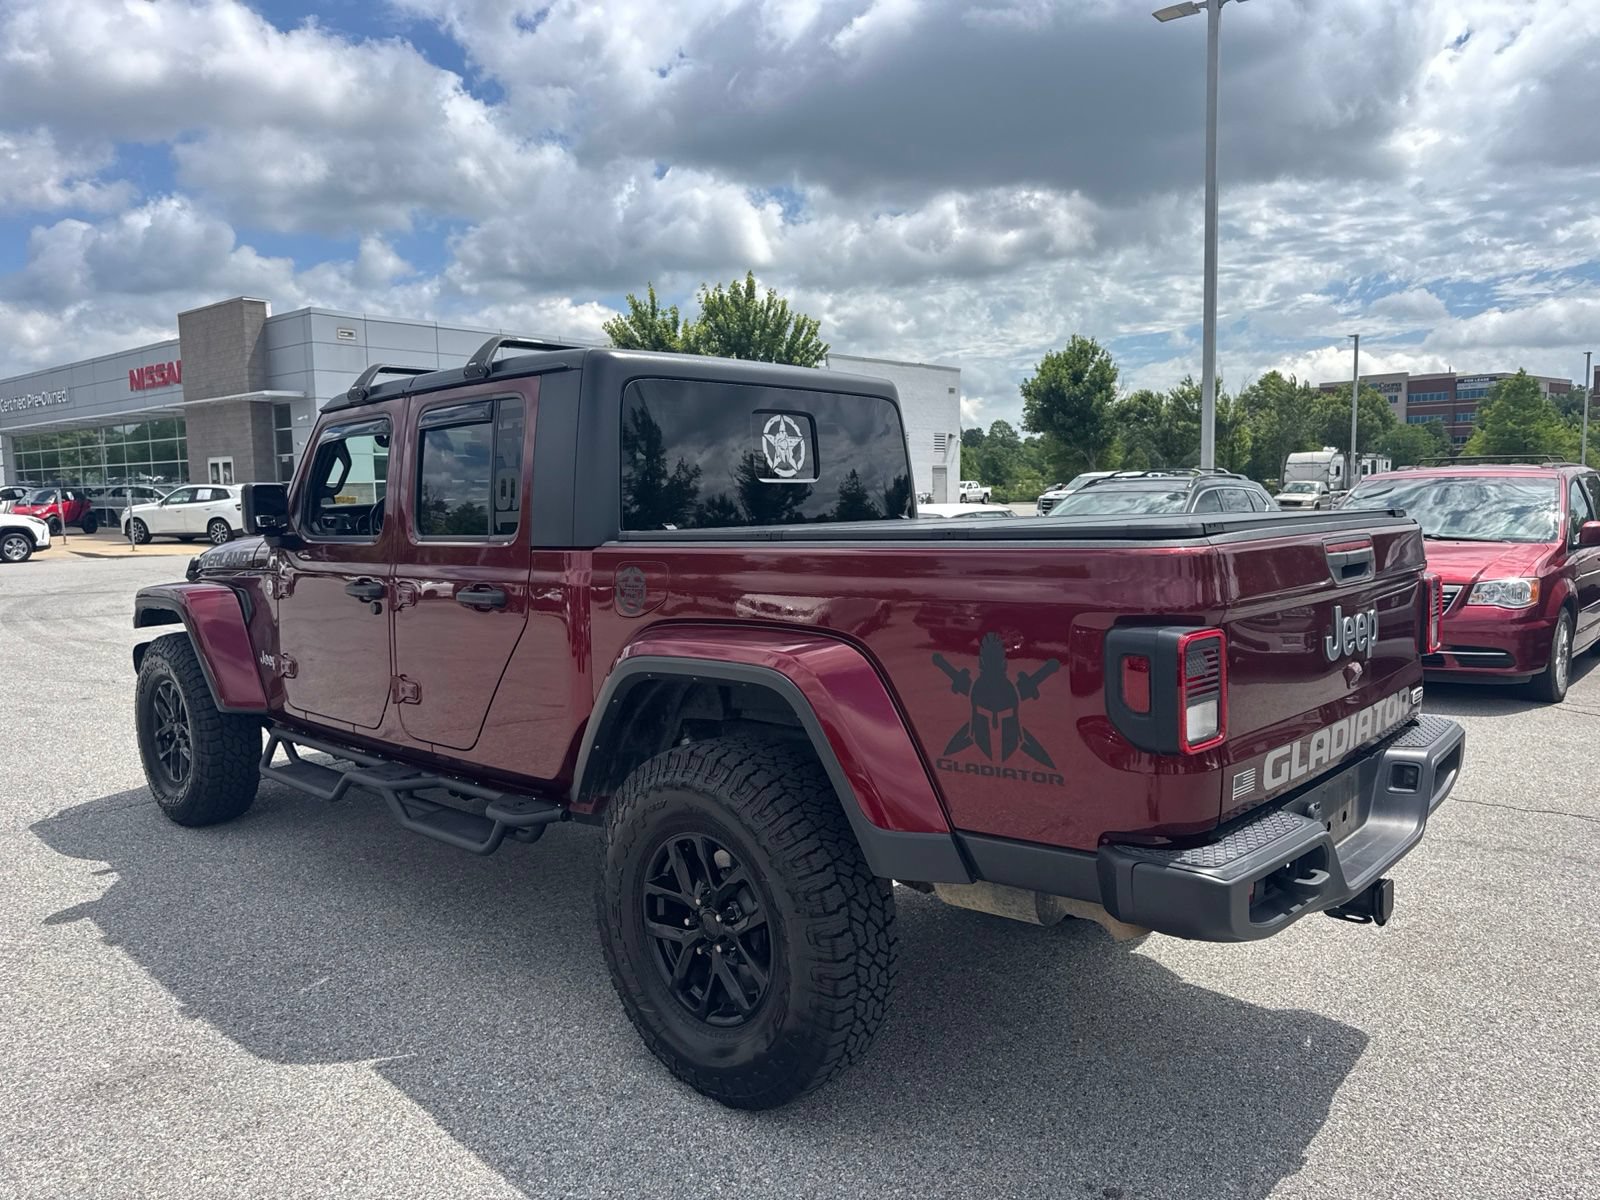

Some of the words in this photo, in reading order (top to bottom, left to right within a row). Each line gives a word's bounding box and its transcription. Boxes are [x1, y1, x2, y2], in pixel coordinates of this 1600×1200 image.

[1325, 605, 1379, 661] Jeep
[260, 650, 276, 671] Jeep
[1263, 686, 1410, 790] GLADIATOR
[936, 758, 1065, 787] GLADIATOR
